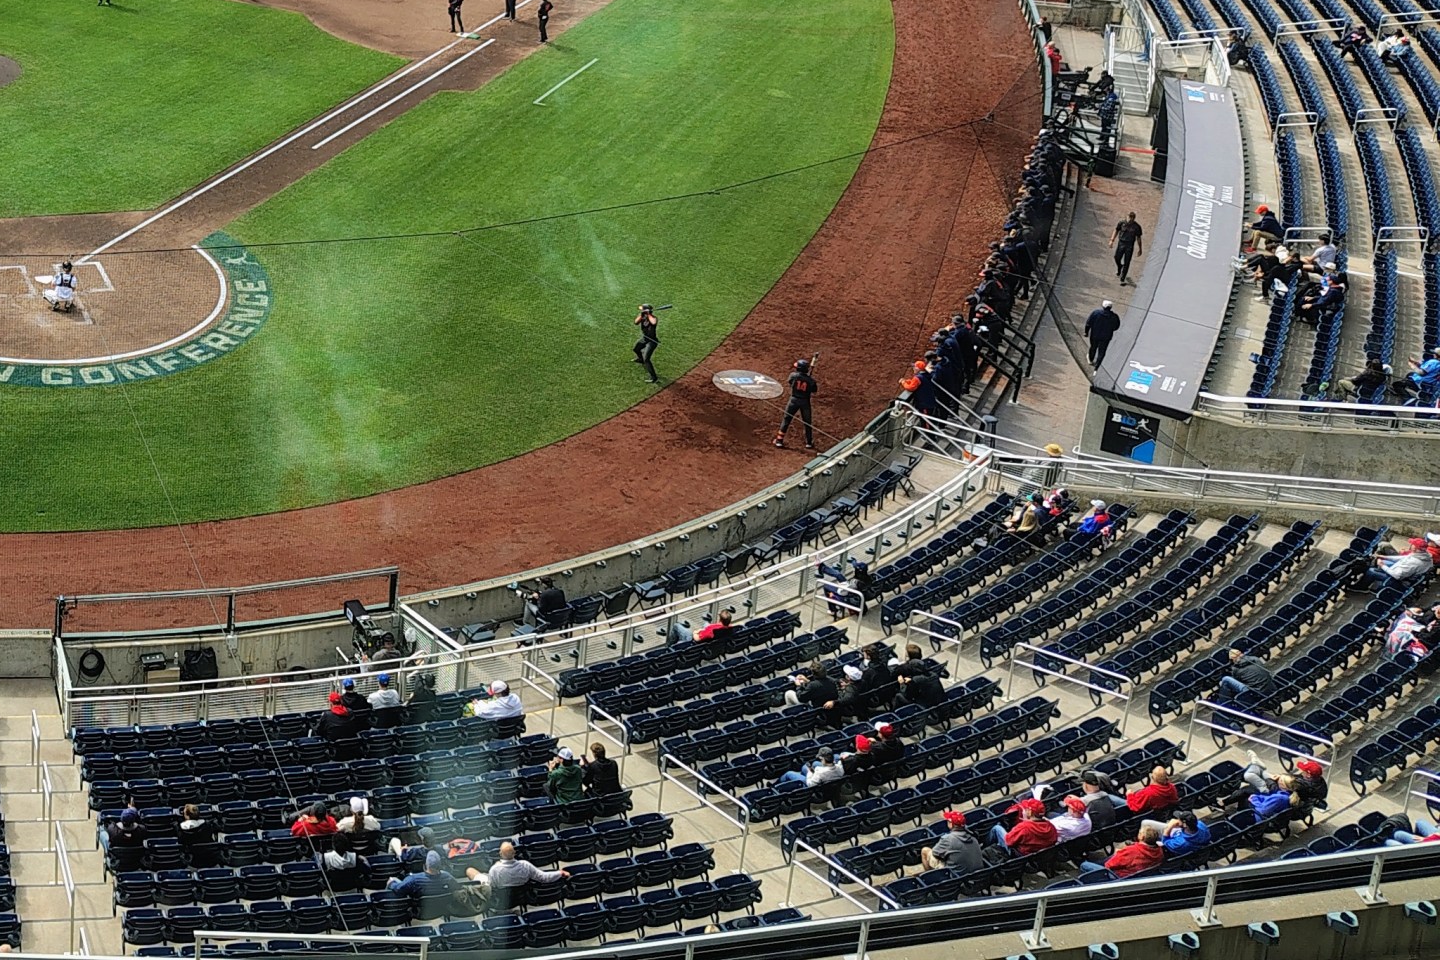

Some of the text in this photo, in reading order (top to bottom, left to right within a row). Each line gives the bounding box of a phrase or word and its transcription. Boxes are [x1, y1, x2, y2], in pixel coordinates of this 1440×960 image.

[1186, 179, 1223, 206] field
[41, 279, 268, 385] CONFERENCE
[796, 380, 808, 391] 14
